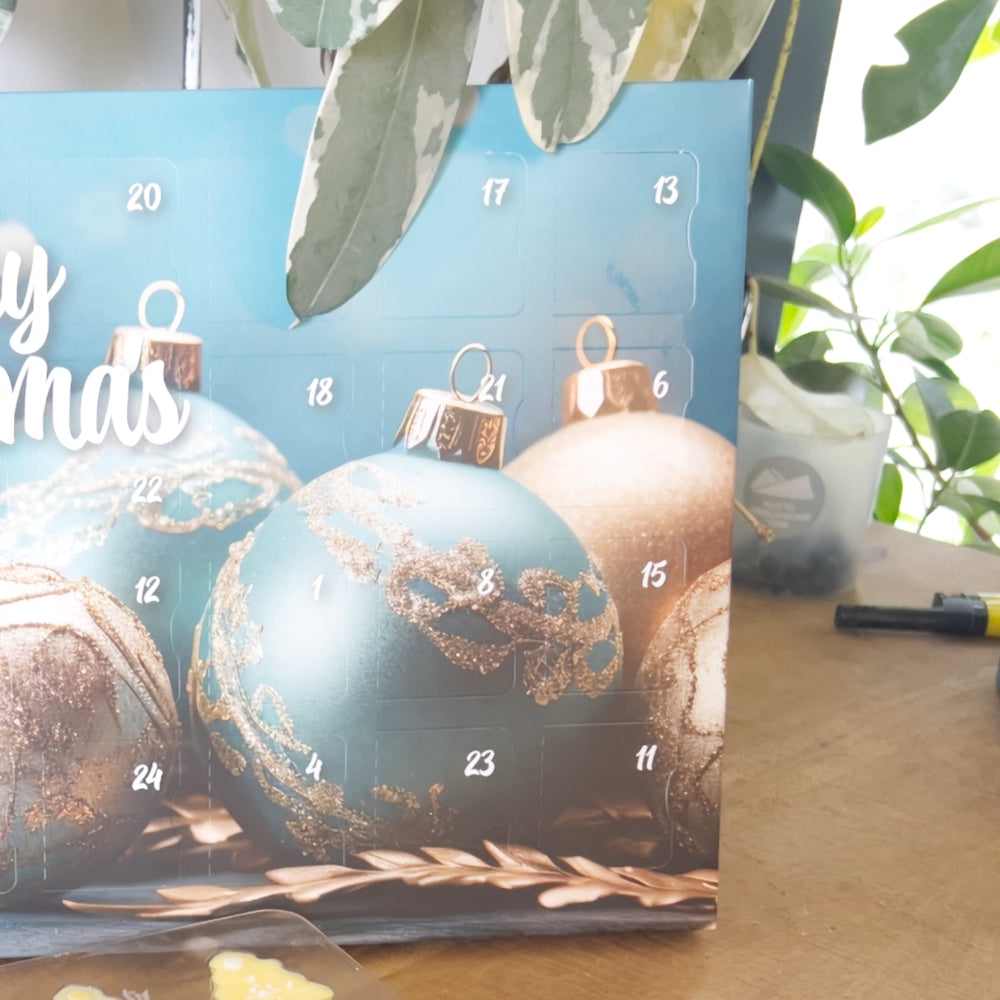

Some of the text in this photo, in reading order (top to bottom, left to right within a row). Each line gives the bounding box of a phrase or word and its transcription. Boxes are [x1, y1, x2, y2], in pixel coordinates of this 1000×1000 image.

[127, 182, 162, 212] 20
[481, 177, 510, 206] 17
[652, 175, 679, 205] 13
[307, 376, 334, 406] 18
[478, 373, 508, 402] 21
[652, 369, 670, 399] 6
[131, 476, 163, 504] 22
[311, 574, 325, 601] 1
[477, 567, 495, 596] 8
[640, 560, 667, 589] 15
[135, 576, 161, 604] 12
[305, 753, 323, 781] 4
[464, 749, 496, 777] 23
[636, 745, 658, 771] 11
[131, 762, 163, 791] 24
